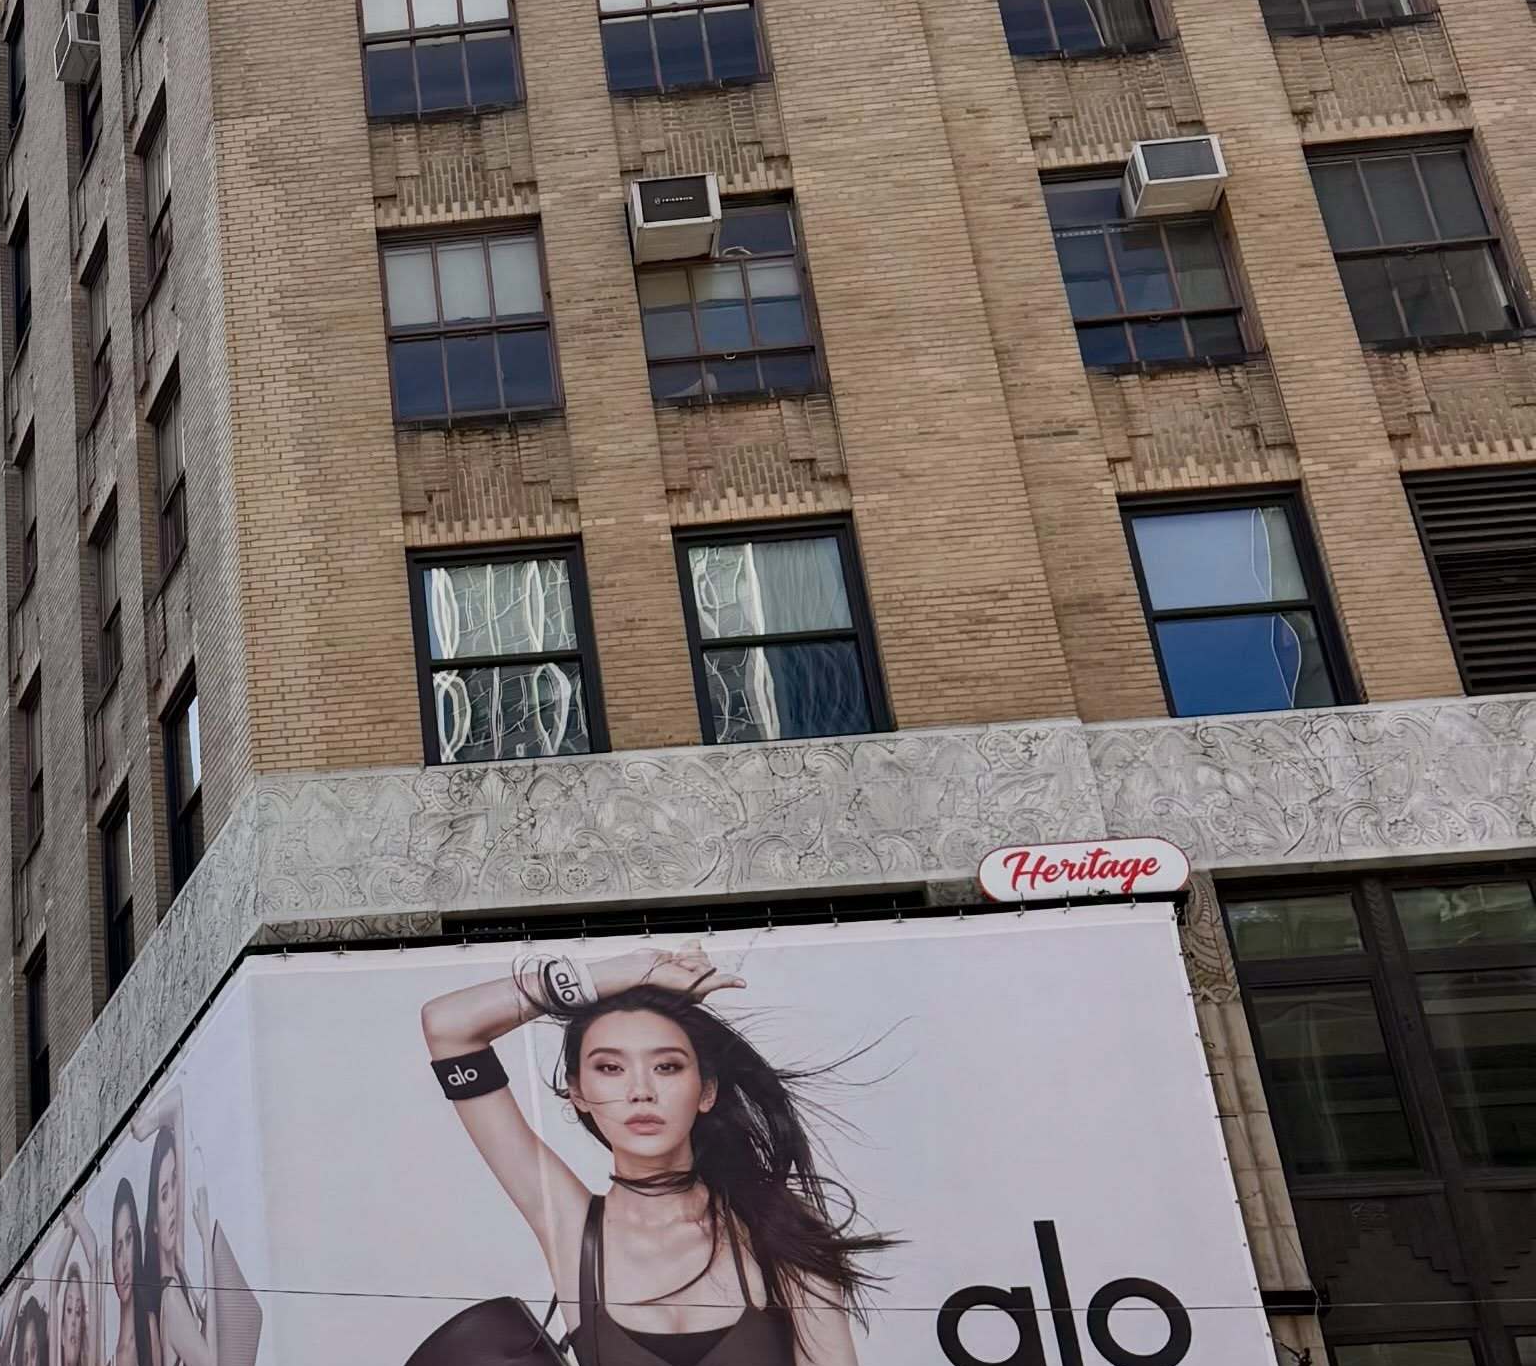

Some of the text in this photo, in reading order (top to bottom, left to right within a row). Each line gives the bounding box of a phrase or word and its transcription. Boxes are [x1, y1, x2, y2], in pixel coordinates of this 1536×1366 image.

[1002, 847, 1161, 894] Heritage
[555, 972, 578, 1002] alo
[447, 1064, 479, 1086] alo
